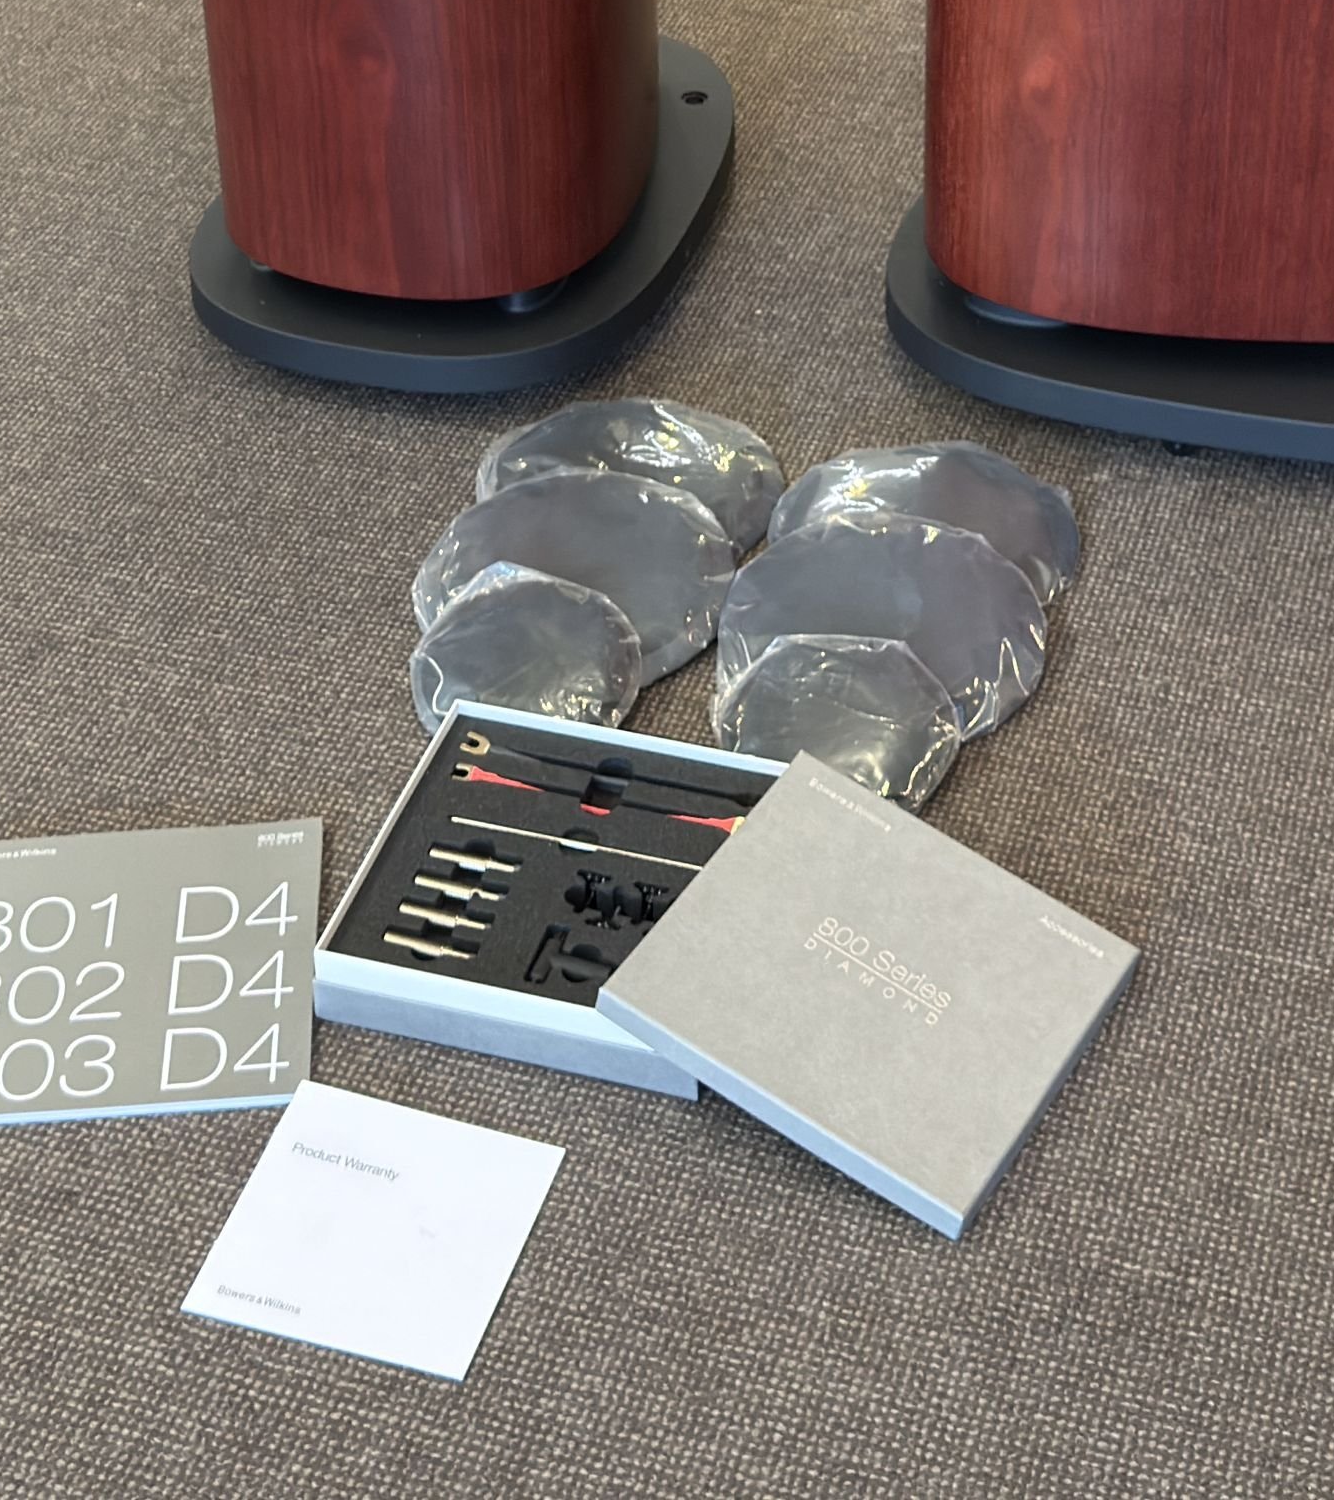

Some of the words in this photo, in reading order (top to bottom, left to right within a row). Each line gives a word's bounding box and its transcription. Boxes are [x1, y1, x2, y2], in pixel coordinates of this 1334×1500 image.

[176, 881, 298, 944] D4
[168, 950, 294, 1015] D4
[803, 937, 939, 1025] DIAMOND
[818, 917, 870, 956] 800
[872, 950, 952, 1008] Series
[160, 1023, 290, 1091] D4
[292, 1141, 342, 1165] Product
[345, 1155, 399, 1181] Warranty
